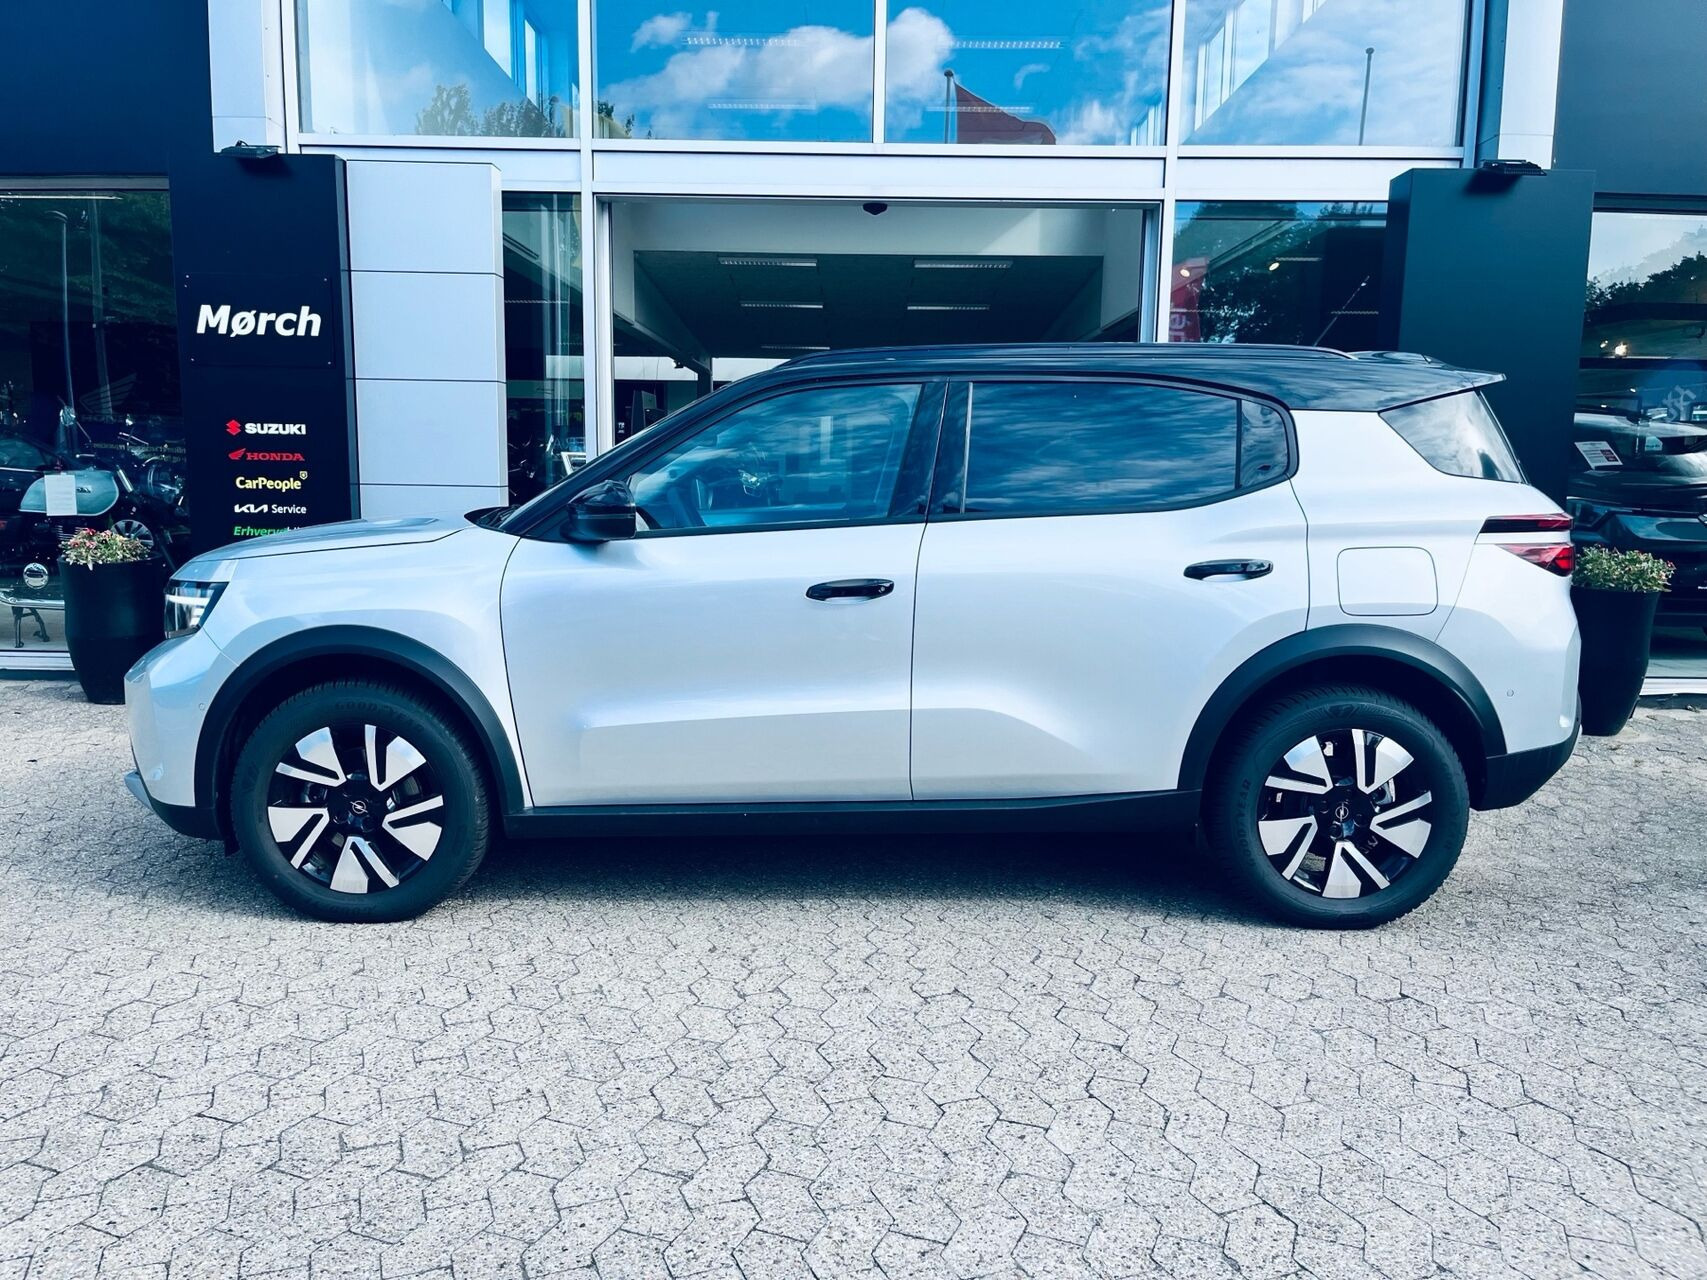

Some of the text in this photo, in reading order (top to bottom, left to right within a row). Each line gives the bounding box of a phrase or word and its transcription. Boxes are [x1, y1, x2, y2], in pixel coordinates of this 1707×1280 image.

[196, 304, 322, 338] Mørch
[244, 423, 307, 435] SUZUKI
[246, 452, 305, 462] HONDA
[235, 476, 302, 493] CarPeople
[233, 503, 307, 514] KIA Service
